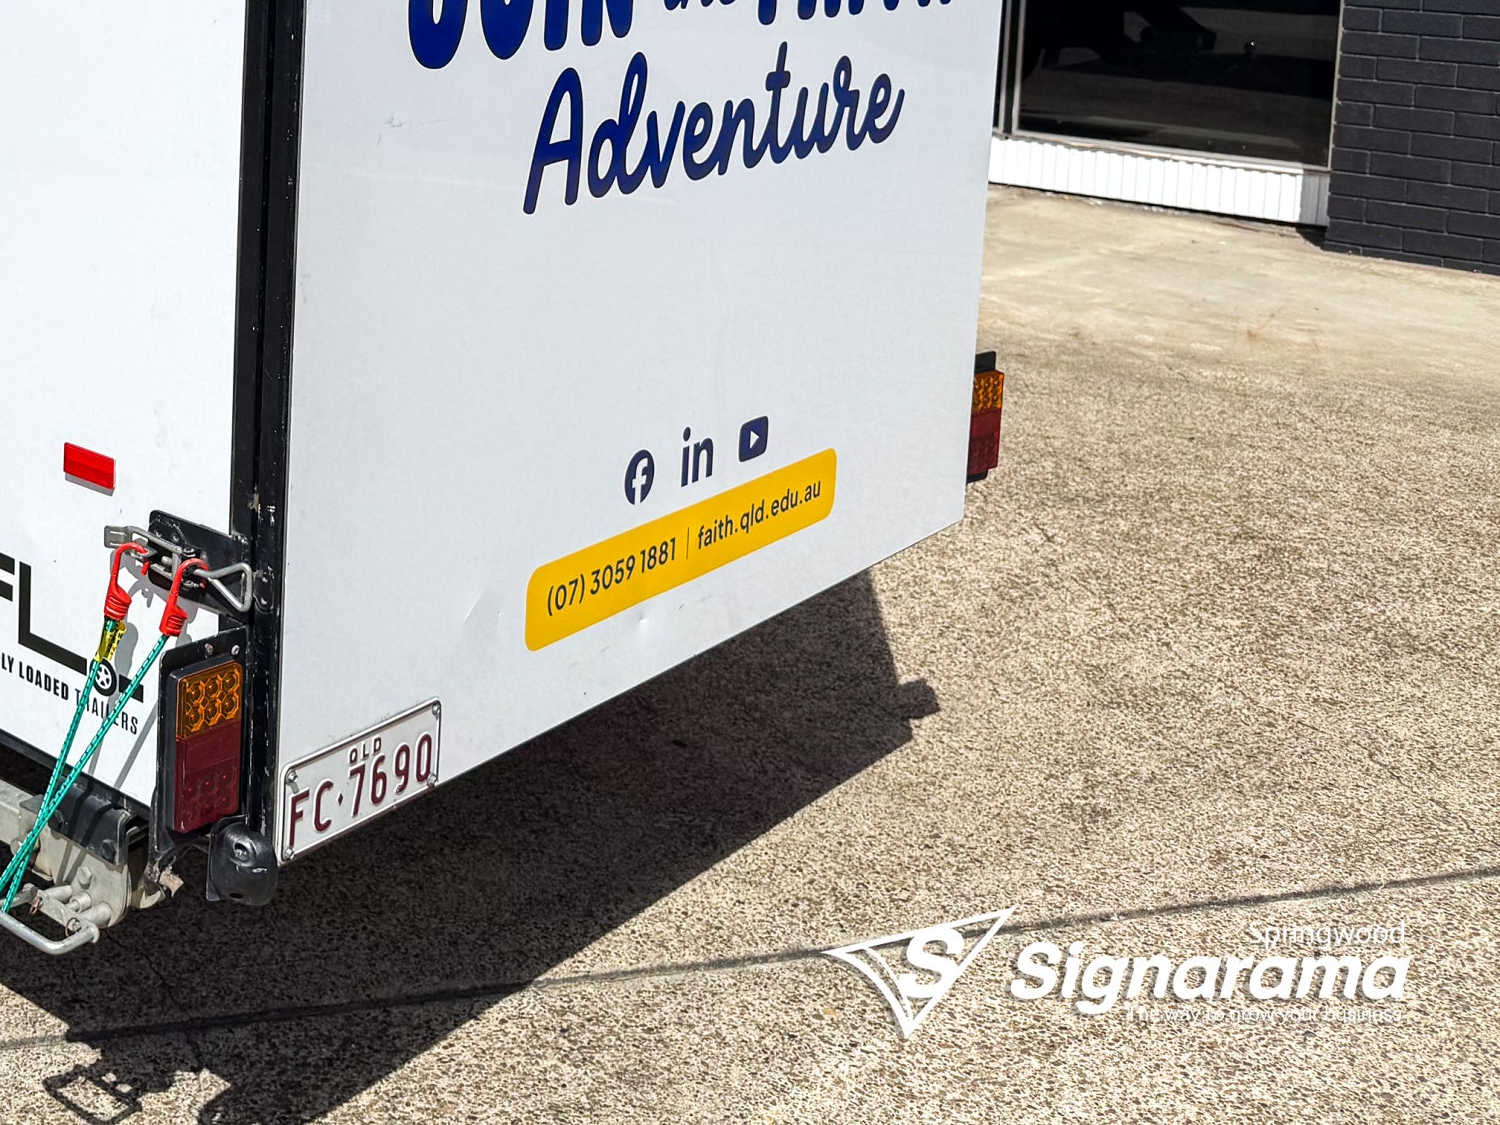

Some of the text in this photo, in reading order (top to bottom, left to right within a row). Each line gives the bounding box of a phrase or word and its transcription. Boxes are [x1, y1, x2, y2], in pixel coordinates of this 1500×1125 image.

[522, 41, 905, 215] Adventure
[547, 480, 821, 616] (07) 3059 1881 faith.qld.edu.au
[18, 661, 69, 701] LOADED
[349, 736, 382, 764] QLD
